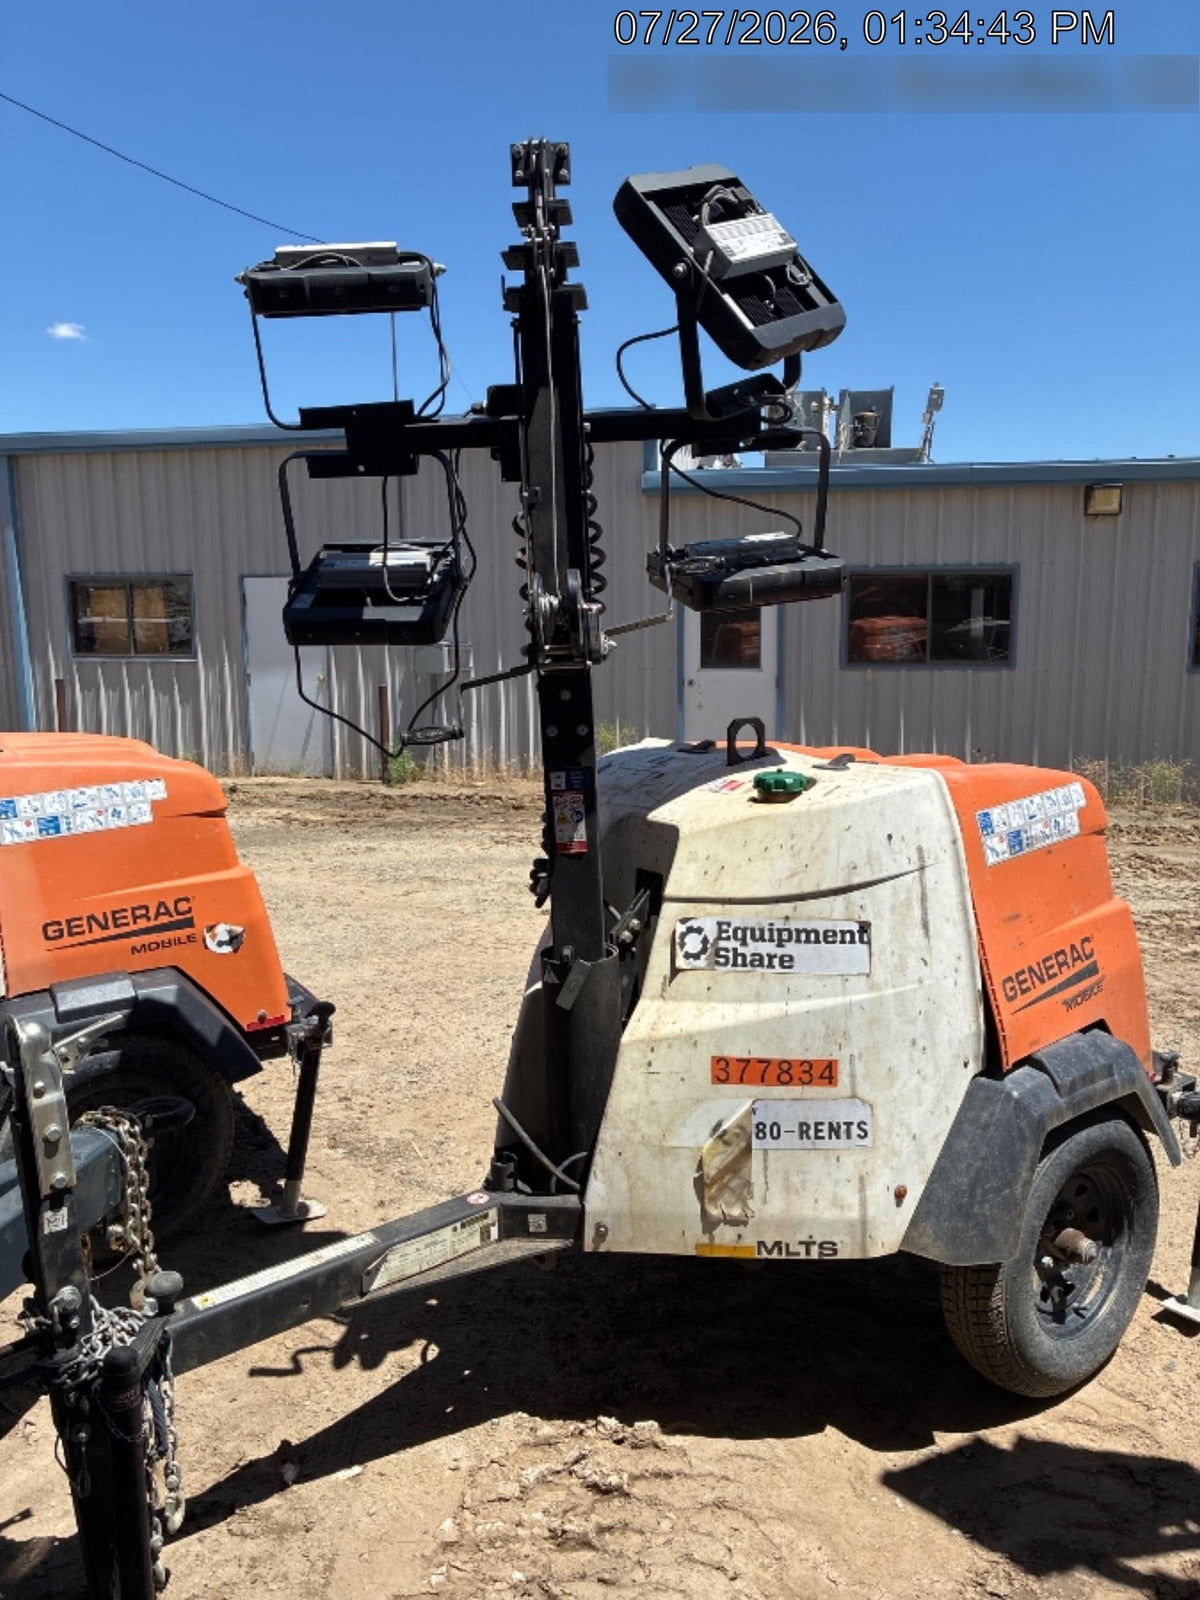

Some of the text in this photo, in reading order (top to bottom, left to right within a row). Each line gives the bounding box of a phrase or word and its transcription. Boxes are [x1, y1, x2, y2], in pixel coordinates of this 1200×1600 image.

[42, 896, 192, 941] GENERAC
[131, 933, 197, 955] MOBILE
[716, 920, 870, 948] Equipment
[714, 947, 794, 969] Share
[1002, 936, 1094, 1002] GENERAC
[715, 1057, 834, 1085] 377834
[754, 1120, 869, 1141] 80-RENTS
[756, 1240, 838, 1258] MLTS
